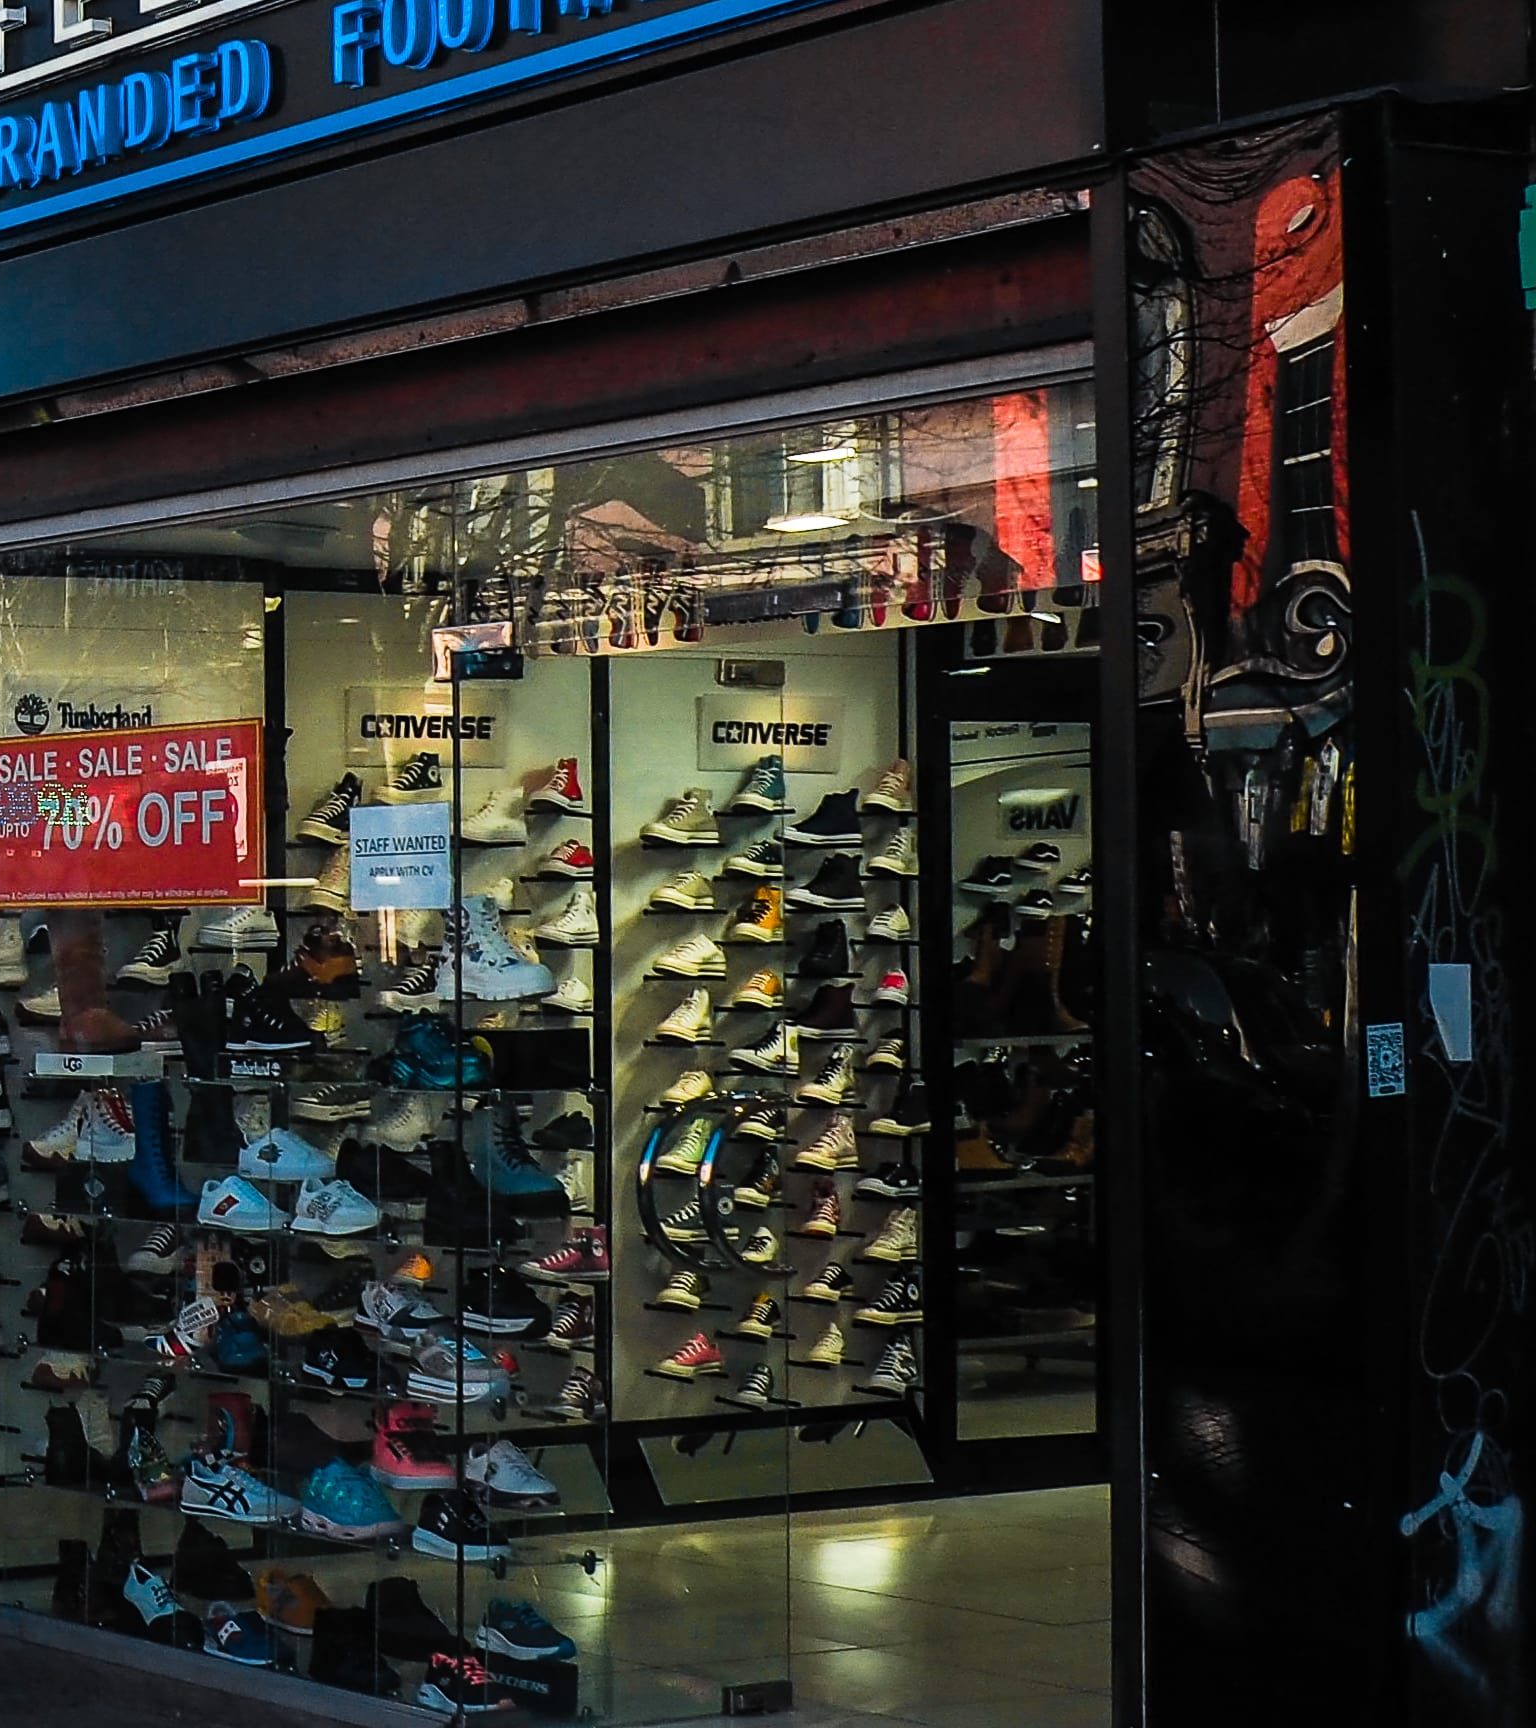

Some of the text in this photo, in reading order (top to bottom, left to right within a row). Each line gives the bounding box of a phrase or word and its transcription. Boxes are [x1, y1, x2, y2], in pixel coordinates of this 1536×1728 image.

[57, 701, 153, 729] Timberland
[360, 714, 496, 739] CONVERSE
[712, 720, 833, 747] CONVERSE
[78, 744, 144, 779] SALE
[163, 737, 233, 774] SALE
[136, 788, 226, 848] OFF
[355, 835, 447, 854] STAFF WANTED
[369, 864, 434, 878] APPLY WITH CV
[62, 1056, 84, 1073] UGG
